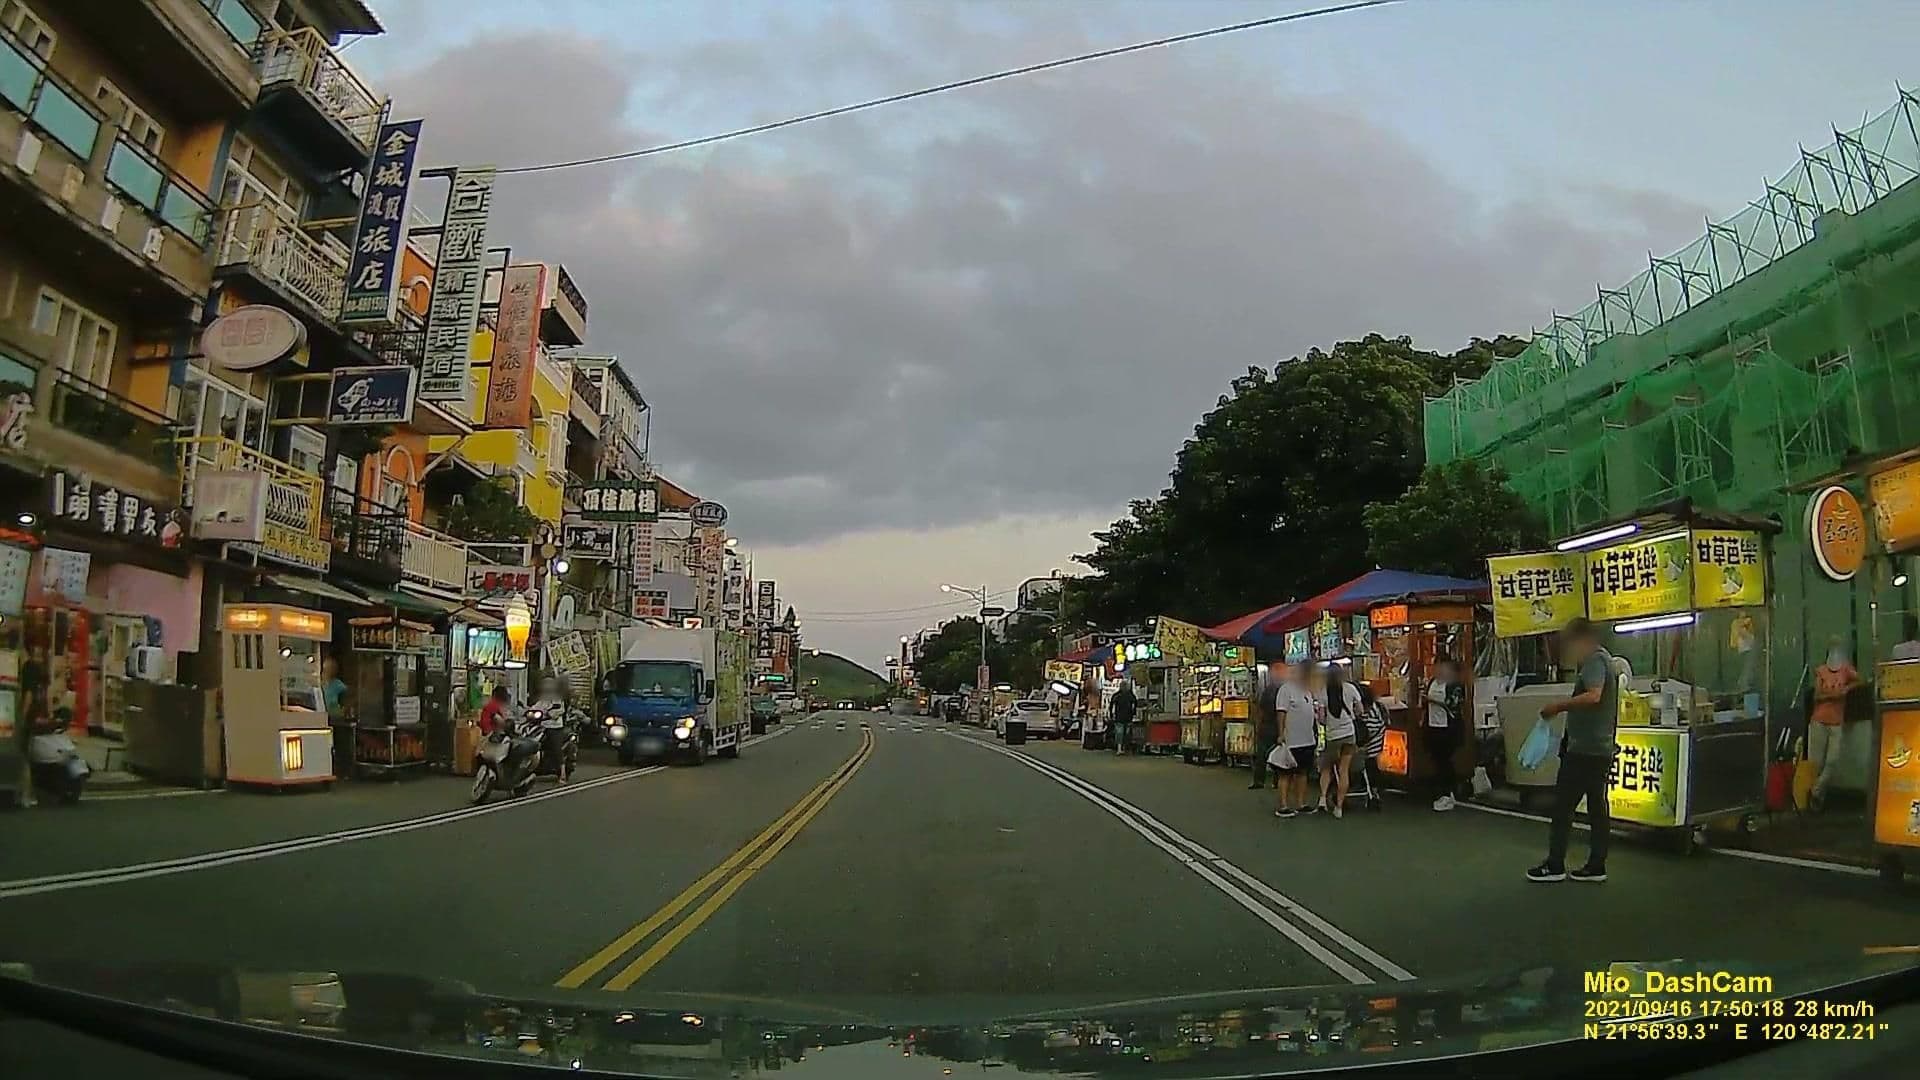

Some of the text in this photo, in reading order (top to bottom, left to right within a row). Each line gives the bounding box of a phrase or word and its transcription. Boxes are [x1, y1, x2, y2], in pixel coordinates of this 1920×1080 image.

[1697, 534, 1758, 566] 甘草芭樂
[1497, 567, 1575, 600] 甘草芭樂
[1590, 545, 1658, 596] 甘草芭樂
